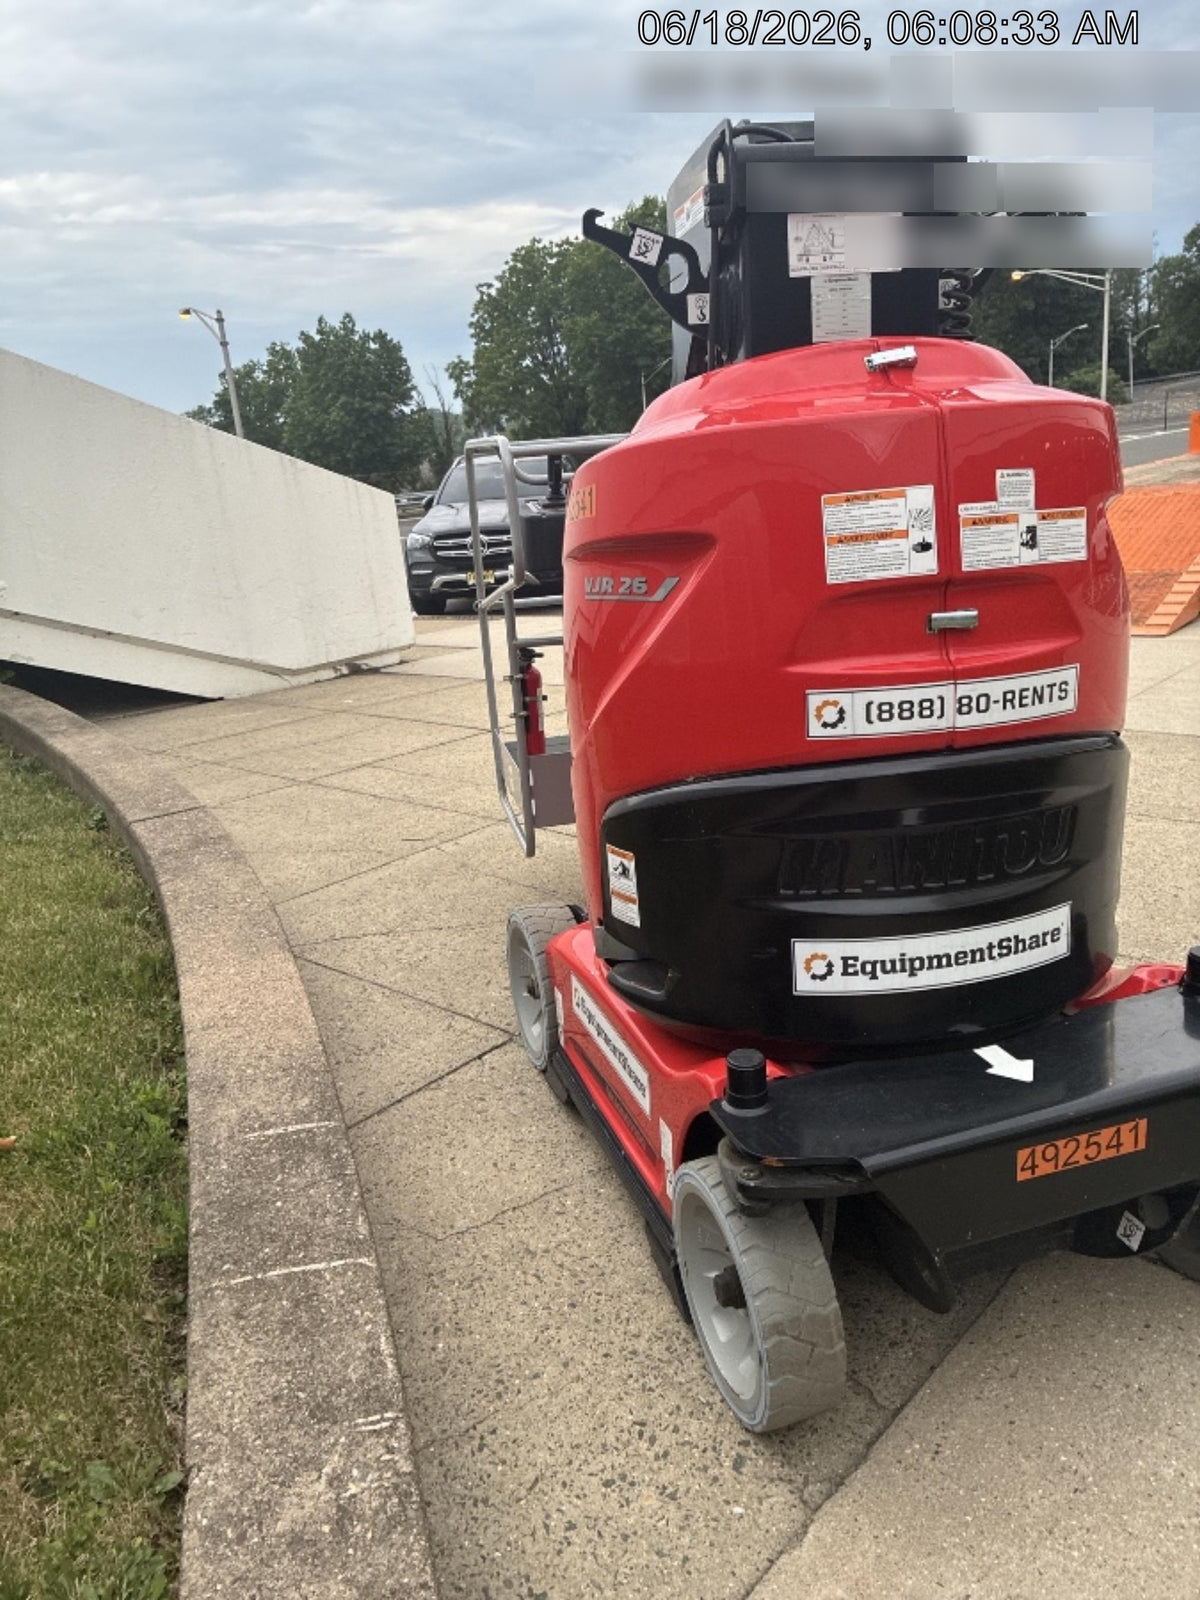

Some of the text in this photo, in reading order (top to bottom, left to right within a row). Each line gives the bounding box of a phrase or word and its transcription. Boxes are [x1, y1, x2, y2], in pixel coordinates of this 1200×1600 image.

[618, 576, 648, 594] 26
[865, 680, 1069, 724] (888) 80-RENTS
[778, 806, 1076, 894] MANITOU
[840, 925, 1063, 980] EquipmentShare
[1020, 1121, 1140, 1176] 492541
